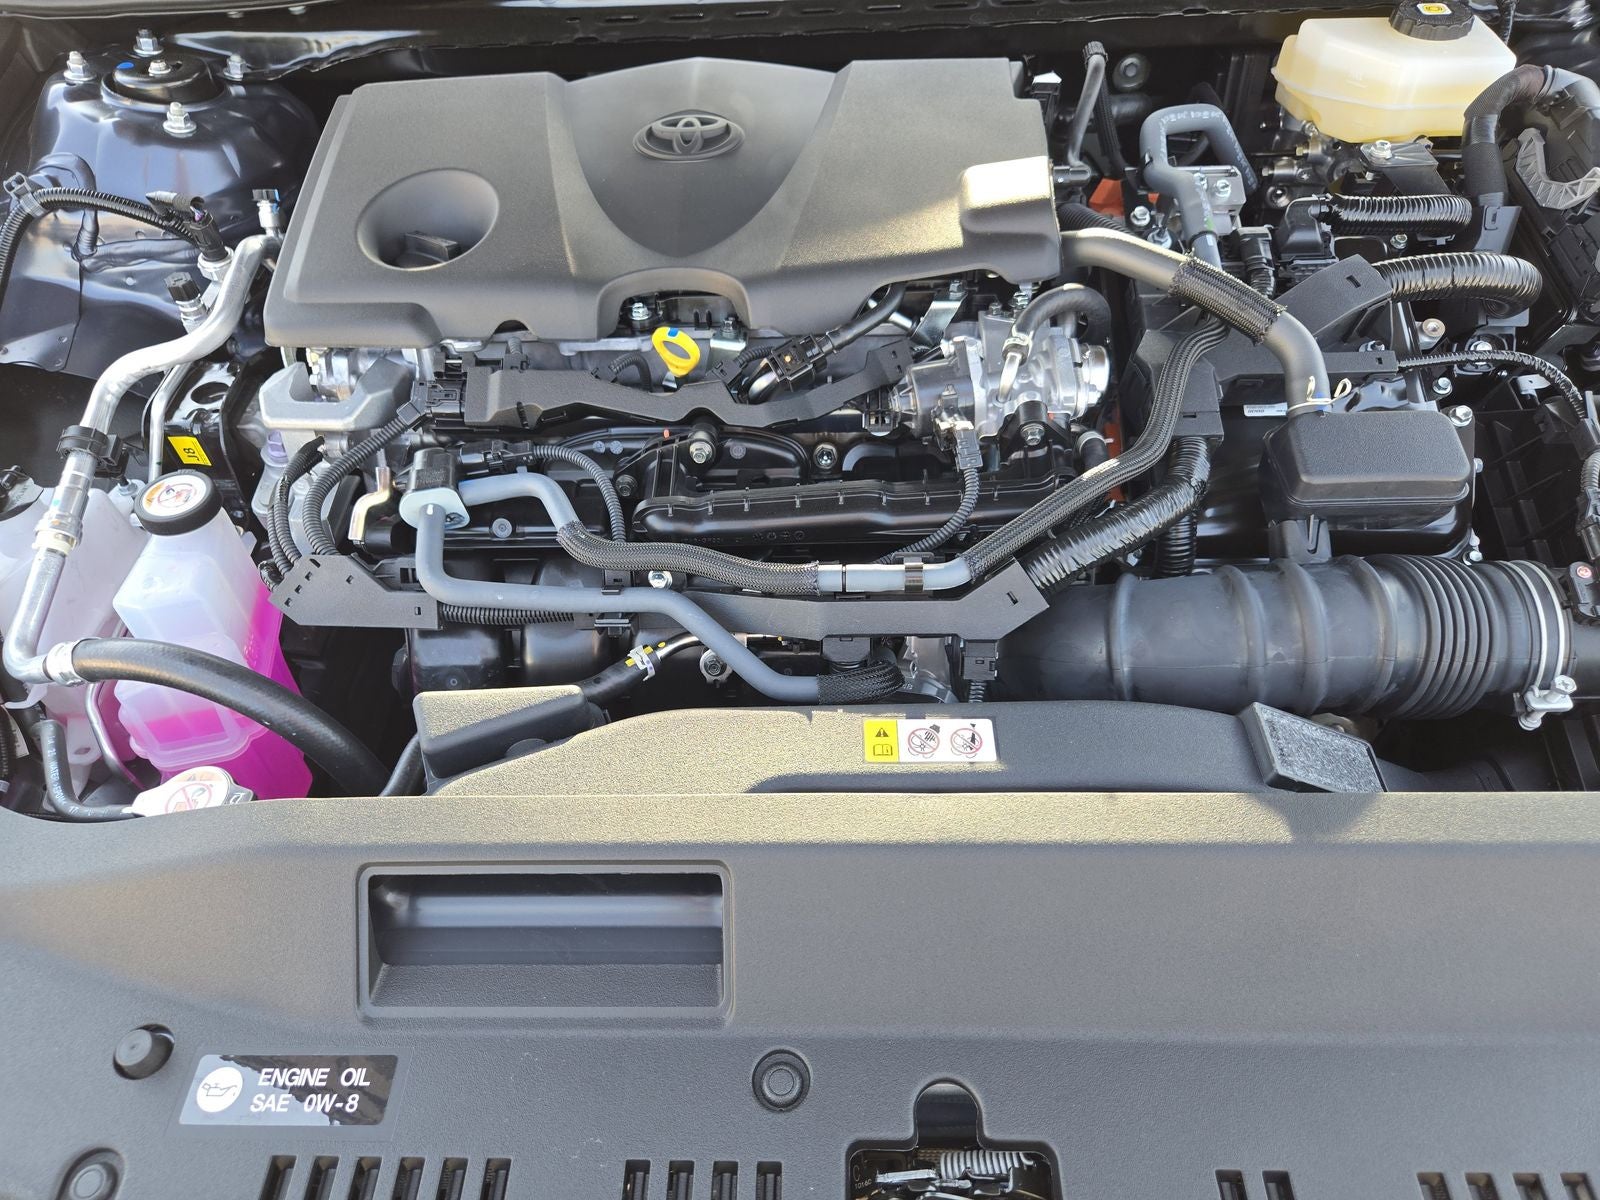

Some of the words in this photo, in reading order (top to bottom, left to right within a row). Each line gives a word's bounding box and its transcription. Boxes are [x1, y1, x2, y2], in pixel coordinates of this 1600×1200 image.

[183, 448, 199, 461] J8
[257, 1067, 331, 1087] ENGINE
[340, 1067, 371, 1087] OIL
[250, 1093, 292, 1113] SAE
[303, 1093, 360, 1113] 0W-8
